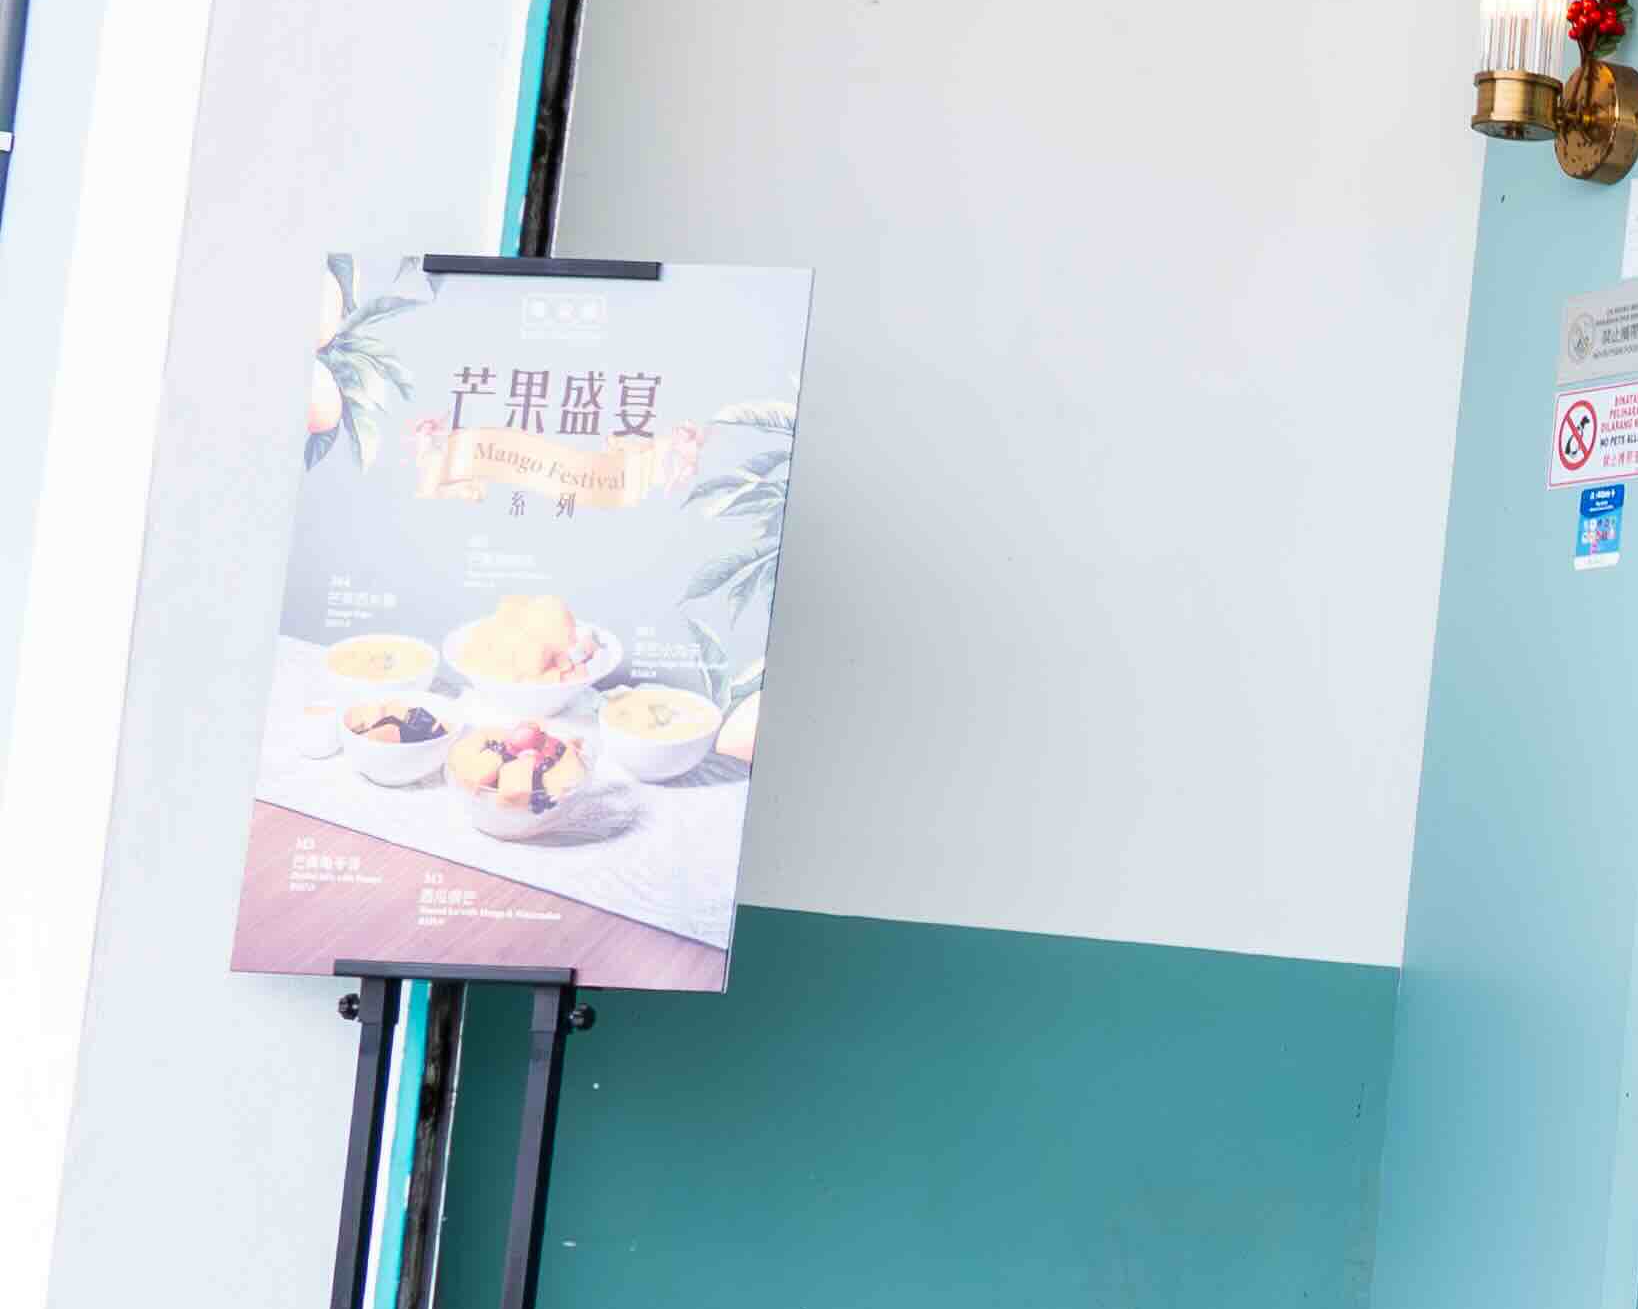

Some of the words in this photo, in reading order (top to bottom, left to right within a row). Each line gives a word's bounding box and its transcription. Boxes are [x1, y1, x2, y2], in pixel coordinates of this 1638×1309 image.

[450, 364, 663, 438] 芒果盛宴
[1600, 436, 1609, 447] NO
[1610, 434, 1625, 446] PETS
[473, 442, 544, 475] Mango
[545, 459, 626, 491] Festival
